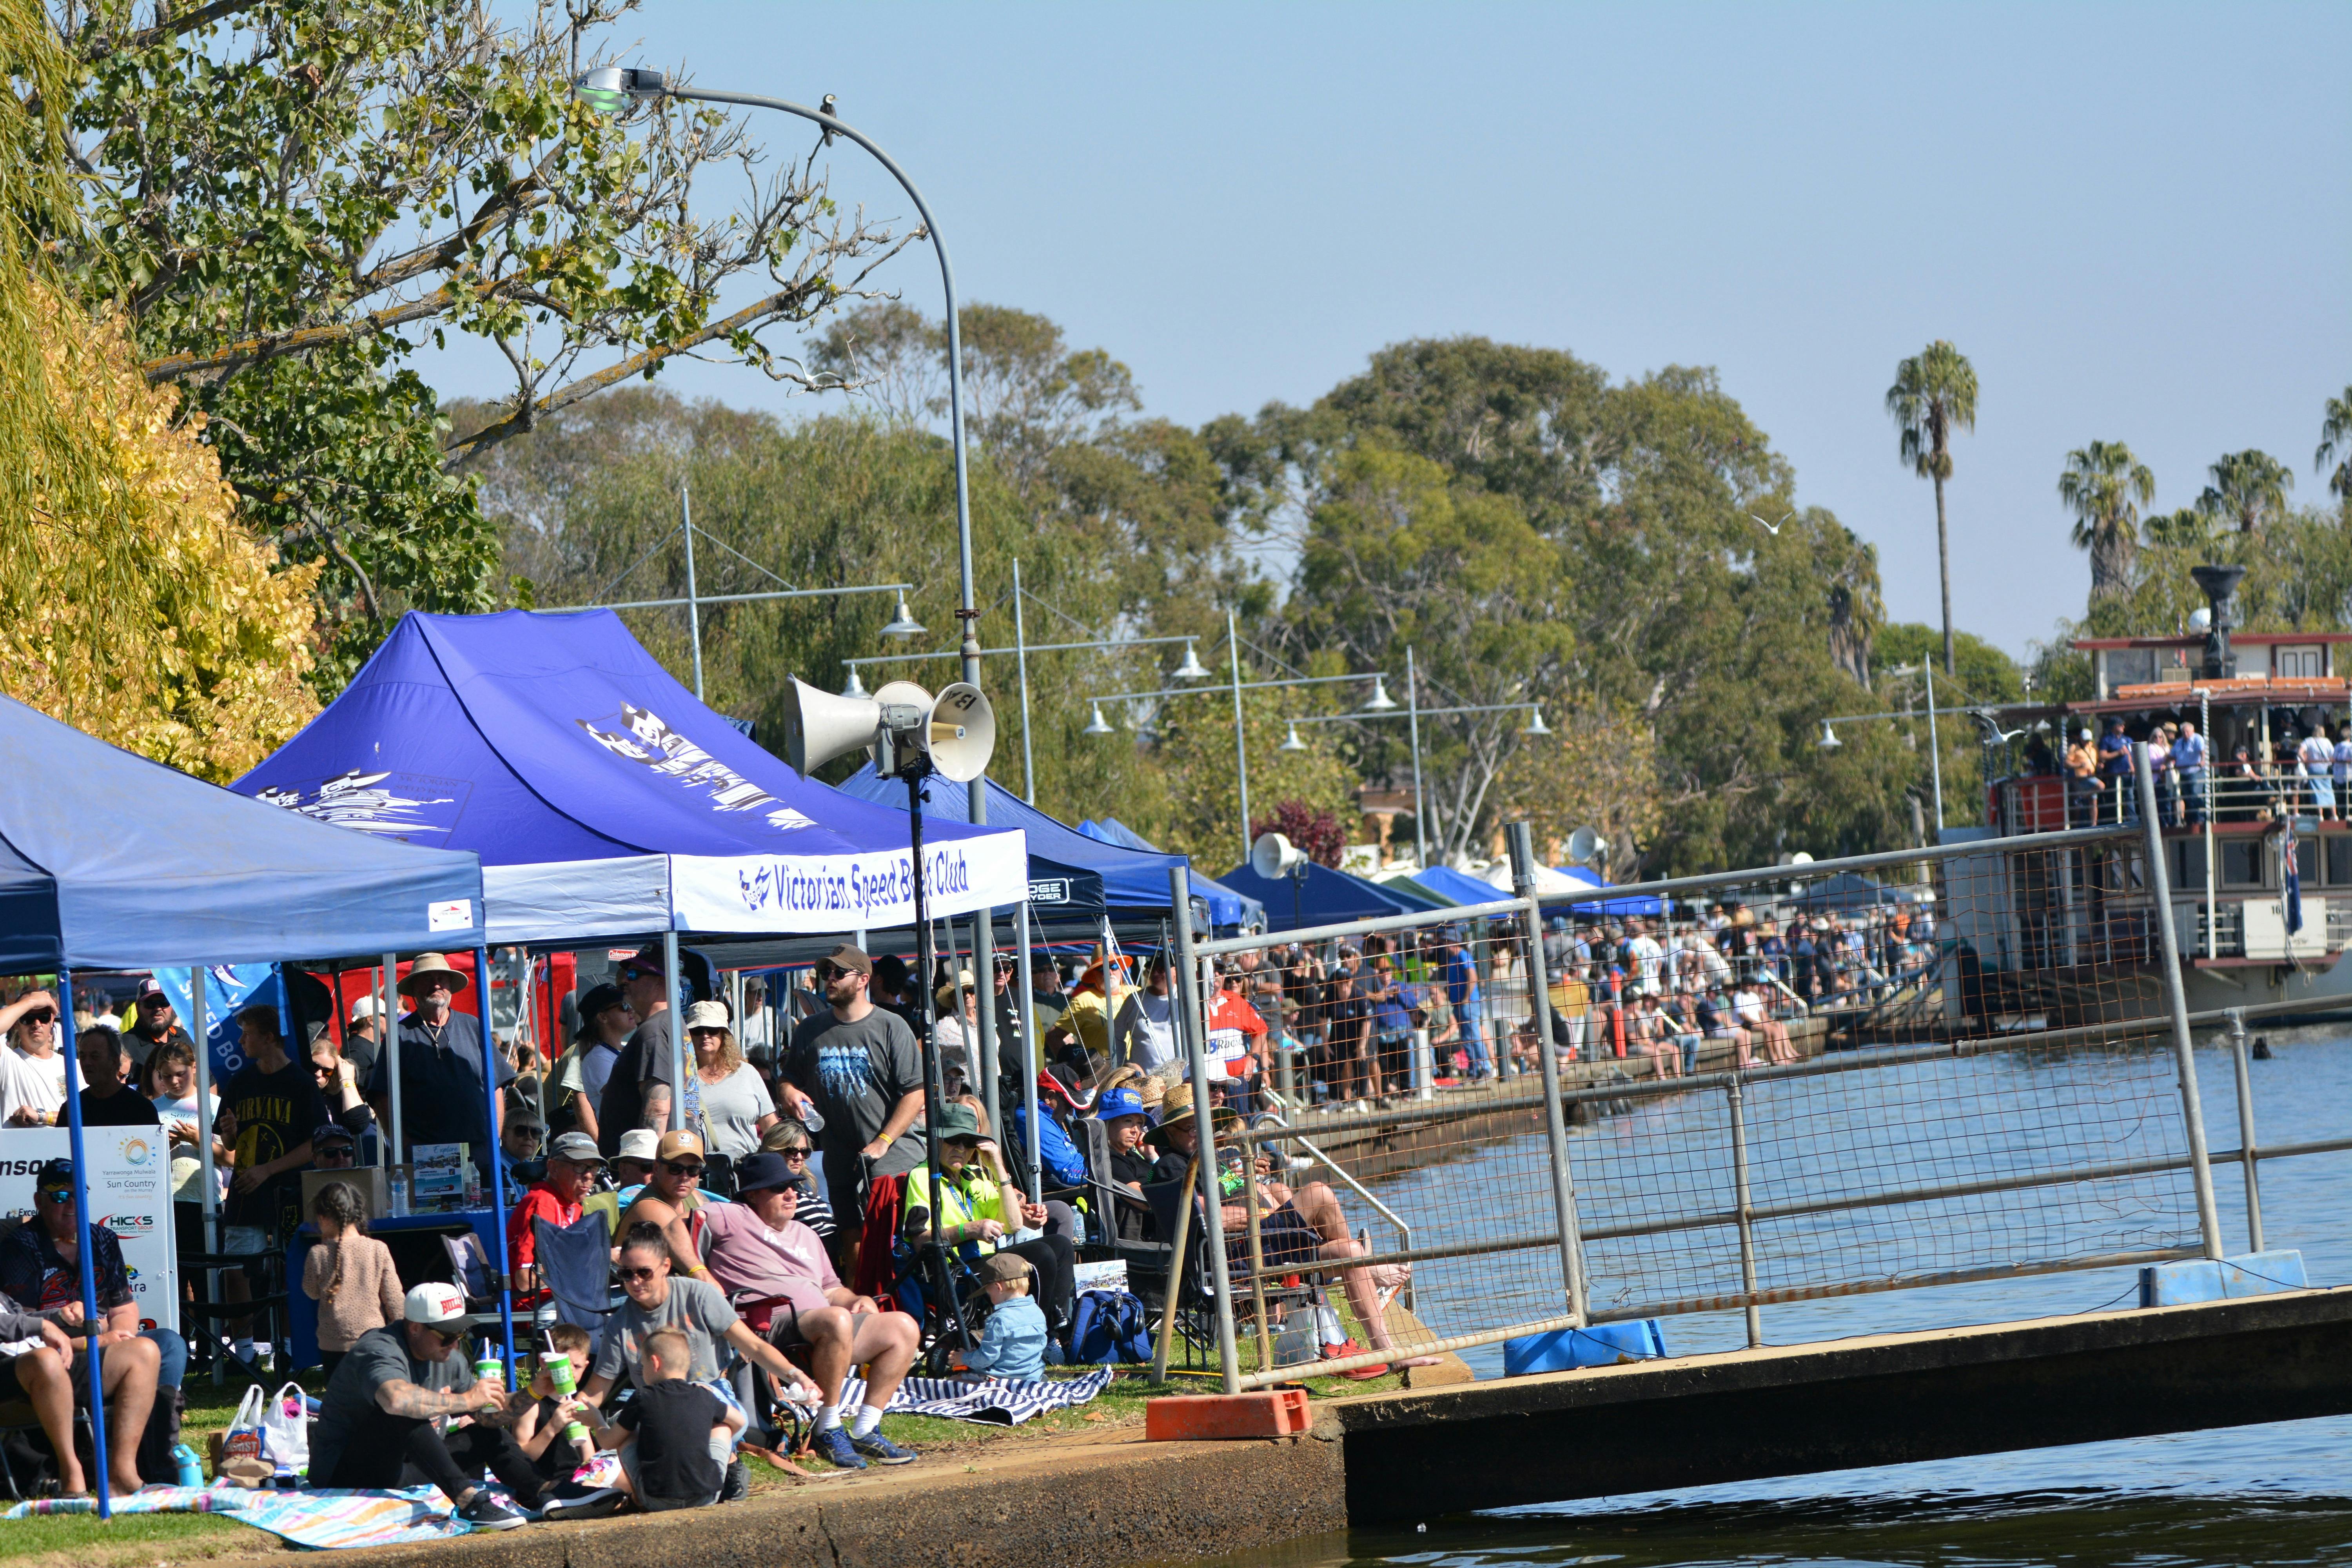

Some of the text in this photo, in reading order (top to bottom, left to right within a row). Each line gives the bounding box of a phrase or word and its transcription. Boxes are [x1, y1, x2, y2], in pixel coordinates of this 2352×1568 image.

[775, 865, 850, 911] Victorian
[851, 864, 898, 919] Speed
[936, 849, 969, 895] Club
[2271, 906, 2281, 914] 16
[235, 1097, 292, 1124] NIRVANA
[433, 1145, 458, 1154] Explore
[124, 1180, 156, 1189] Country
[110, 1216, 153, 1226] HICKS
